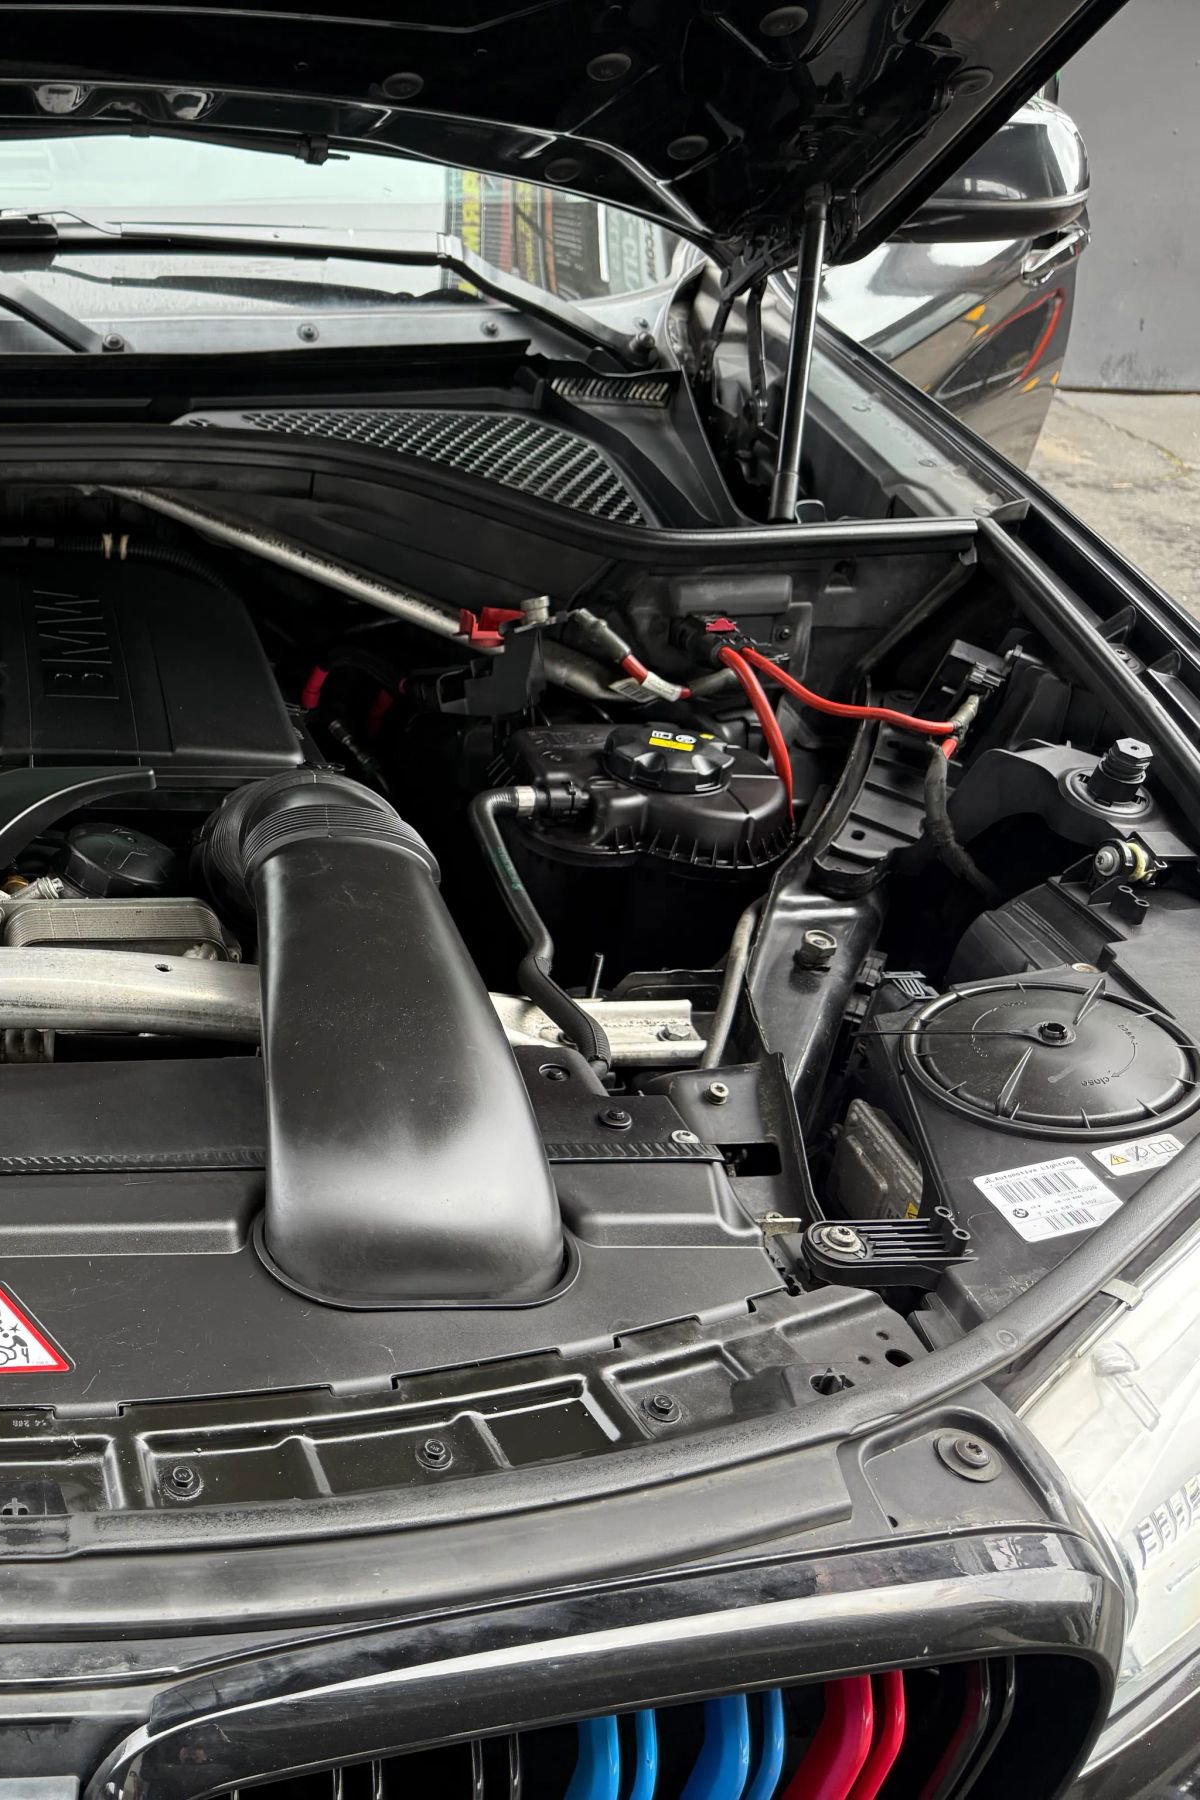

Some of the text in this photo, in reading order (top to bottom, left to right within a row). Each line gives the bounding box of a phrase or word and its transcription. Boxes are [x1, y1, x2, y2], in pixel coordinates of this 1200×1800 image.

[32, 589, 121, 700] BMW
[994, 1159, 1077, 1182] Automotive Lighting
